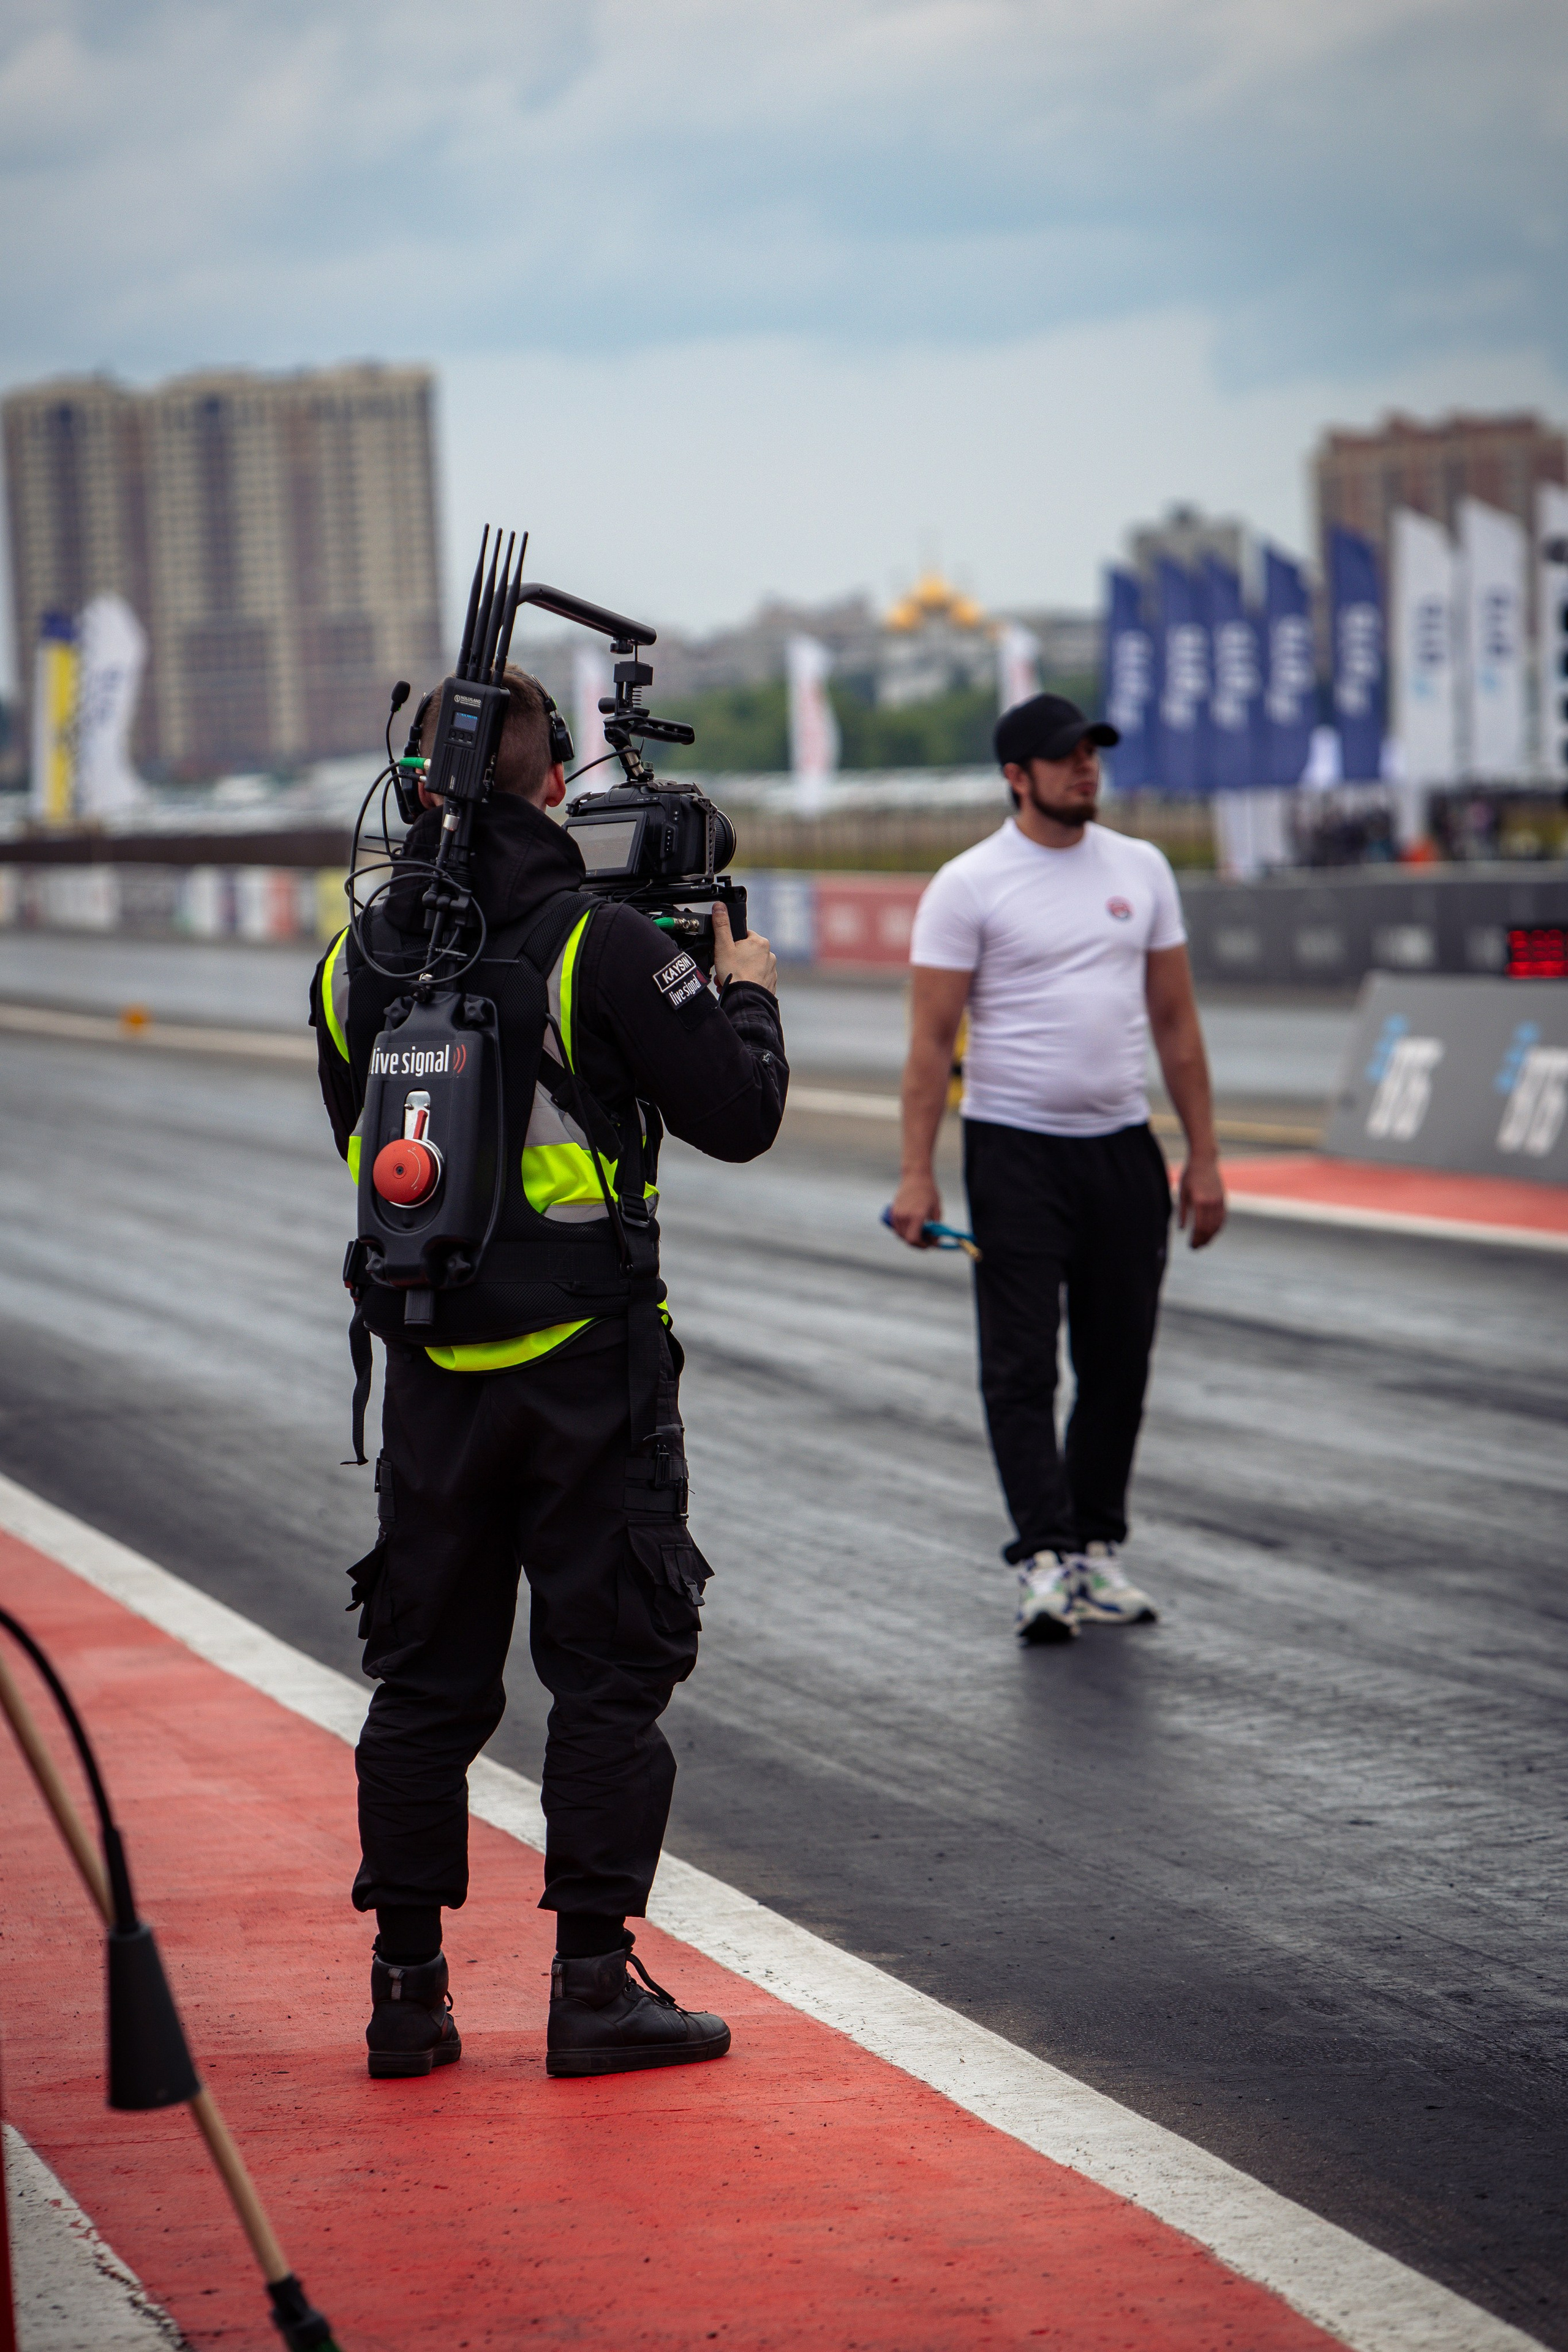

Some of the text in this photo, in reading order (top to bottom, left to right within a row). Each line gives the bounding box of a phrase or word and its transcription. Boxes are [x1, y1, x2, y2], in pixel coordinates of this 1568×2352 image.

[662, 956, 692, 984] KAYSIN
[669, 974, 701, 1006] live signal
[370, 1044, 450, 1077] live signal
